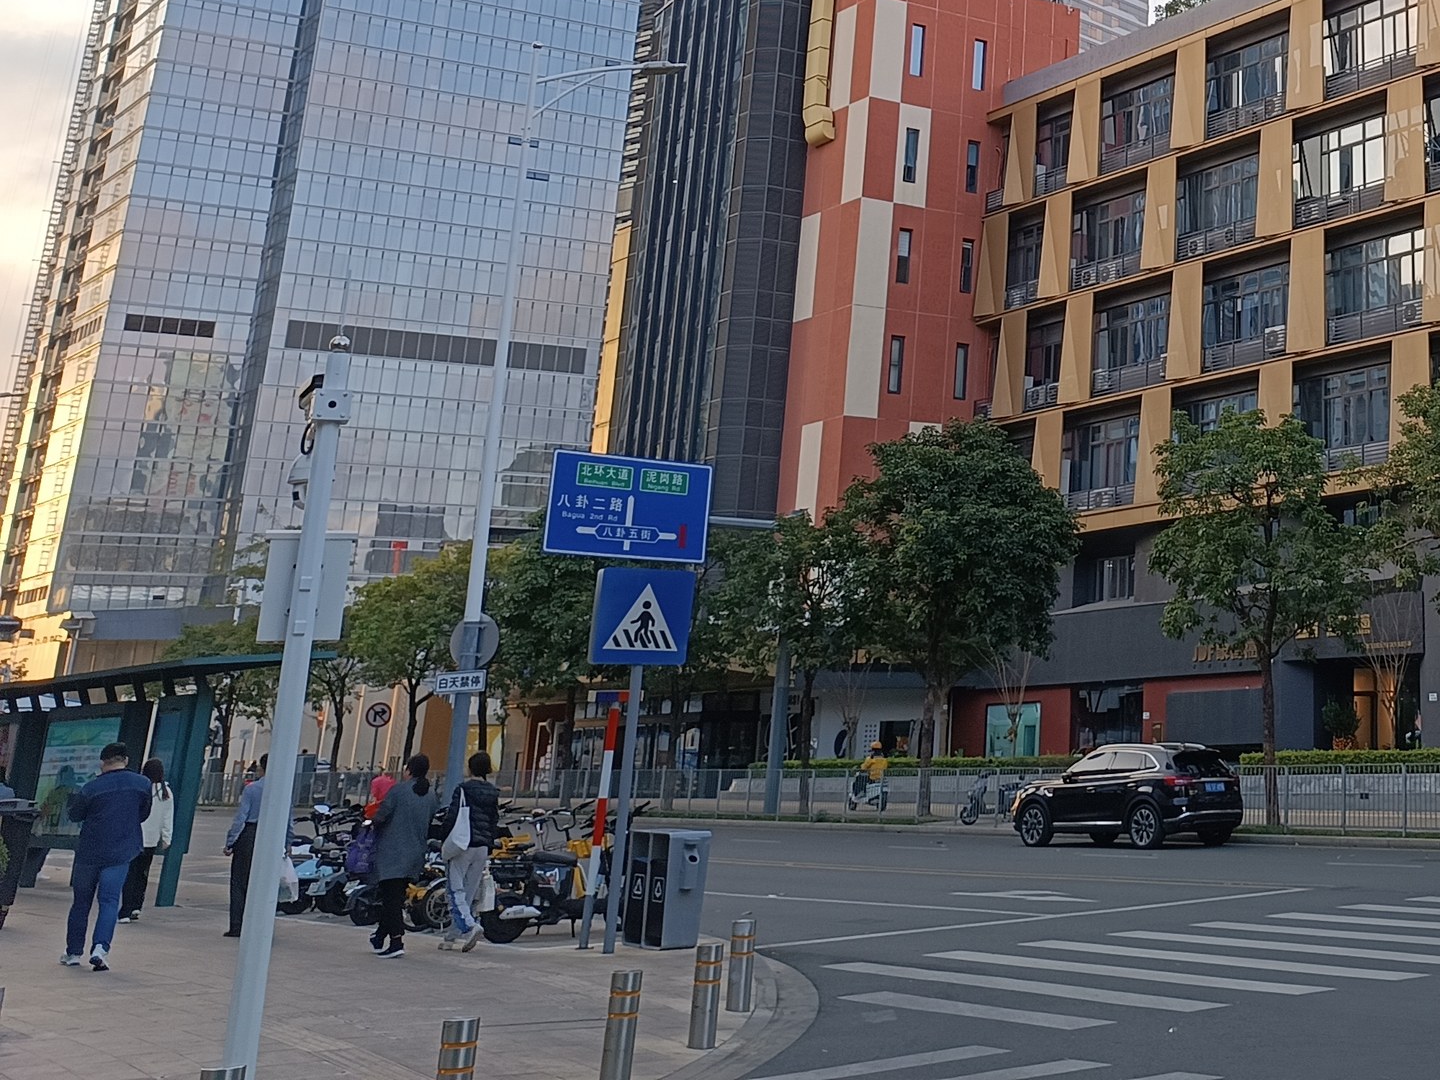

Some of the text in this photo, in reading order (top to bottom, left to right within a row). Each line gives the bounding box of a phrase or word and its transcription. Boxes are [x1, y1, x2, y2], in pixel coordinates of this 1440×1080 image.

[581, 464, 629, 481] 北环大道
[646, 470, 683, 486] 泥岗路
[557, 494, 623, 512] 八卦二路
[562, 510, 618, 522] Bagua 2nd Rd
[602, 526, 651, 540] 八卦五街
[439, 675, 481, 689] 白天禁停
